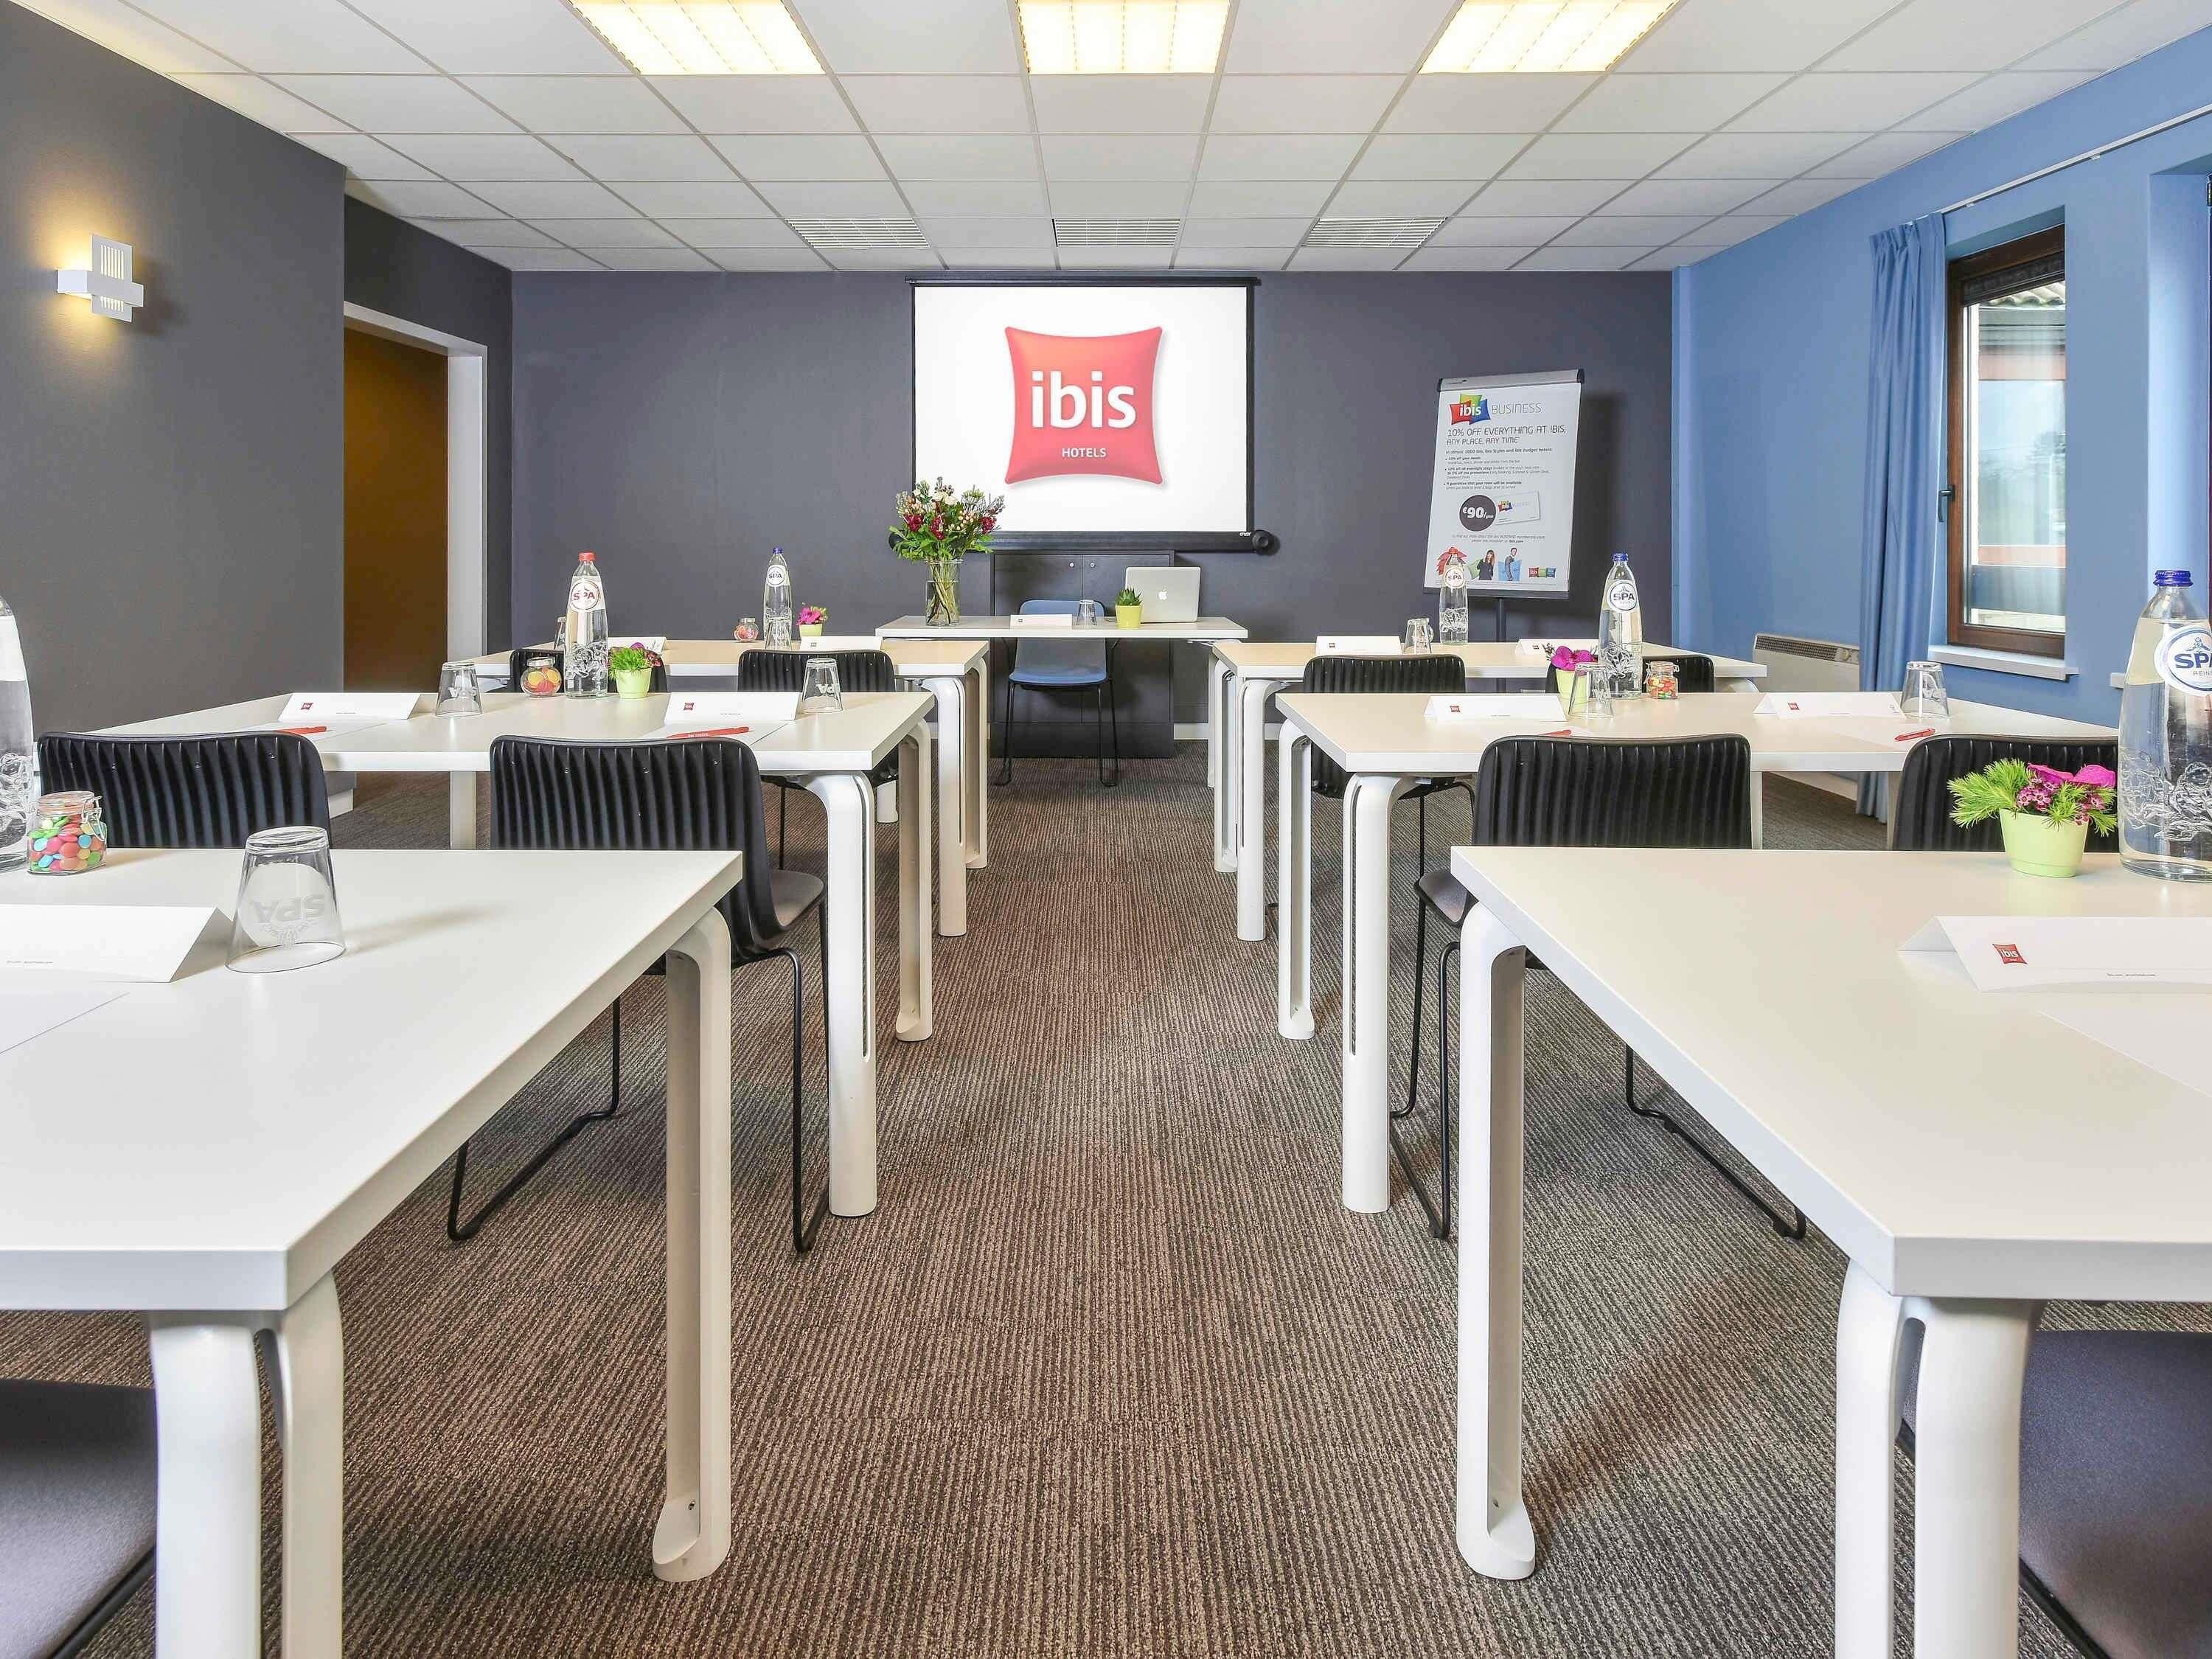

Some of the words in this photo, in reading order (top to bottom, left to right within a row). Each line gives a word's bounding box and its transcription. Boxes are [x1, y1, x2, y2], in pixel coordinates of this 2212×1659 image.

[1032, 370, 1137, 429] ibis
[1459, 403, 1481, 417] ibis
[1491, 402, 1543, 414] BUSINESS
[1447, 428, 1464, 437] 10%
[1467, 428, 1481, 436] OFF
[1484, 425, 1534, 436] EVERYTHING
[1536, 425, 1548, 434] AT
[1061, 447, 1107, 459] HOTELS
[1613, 592, 1635, 602] SPA
